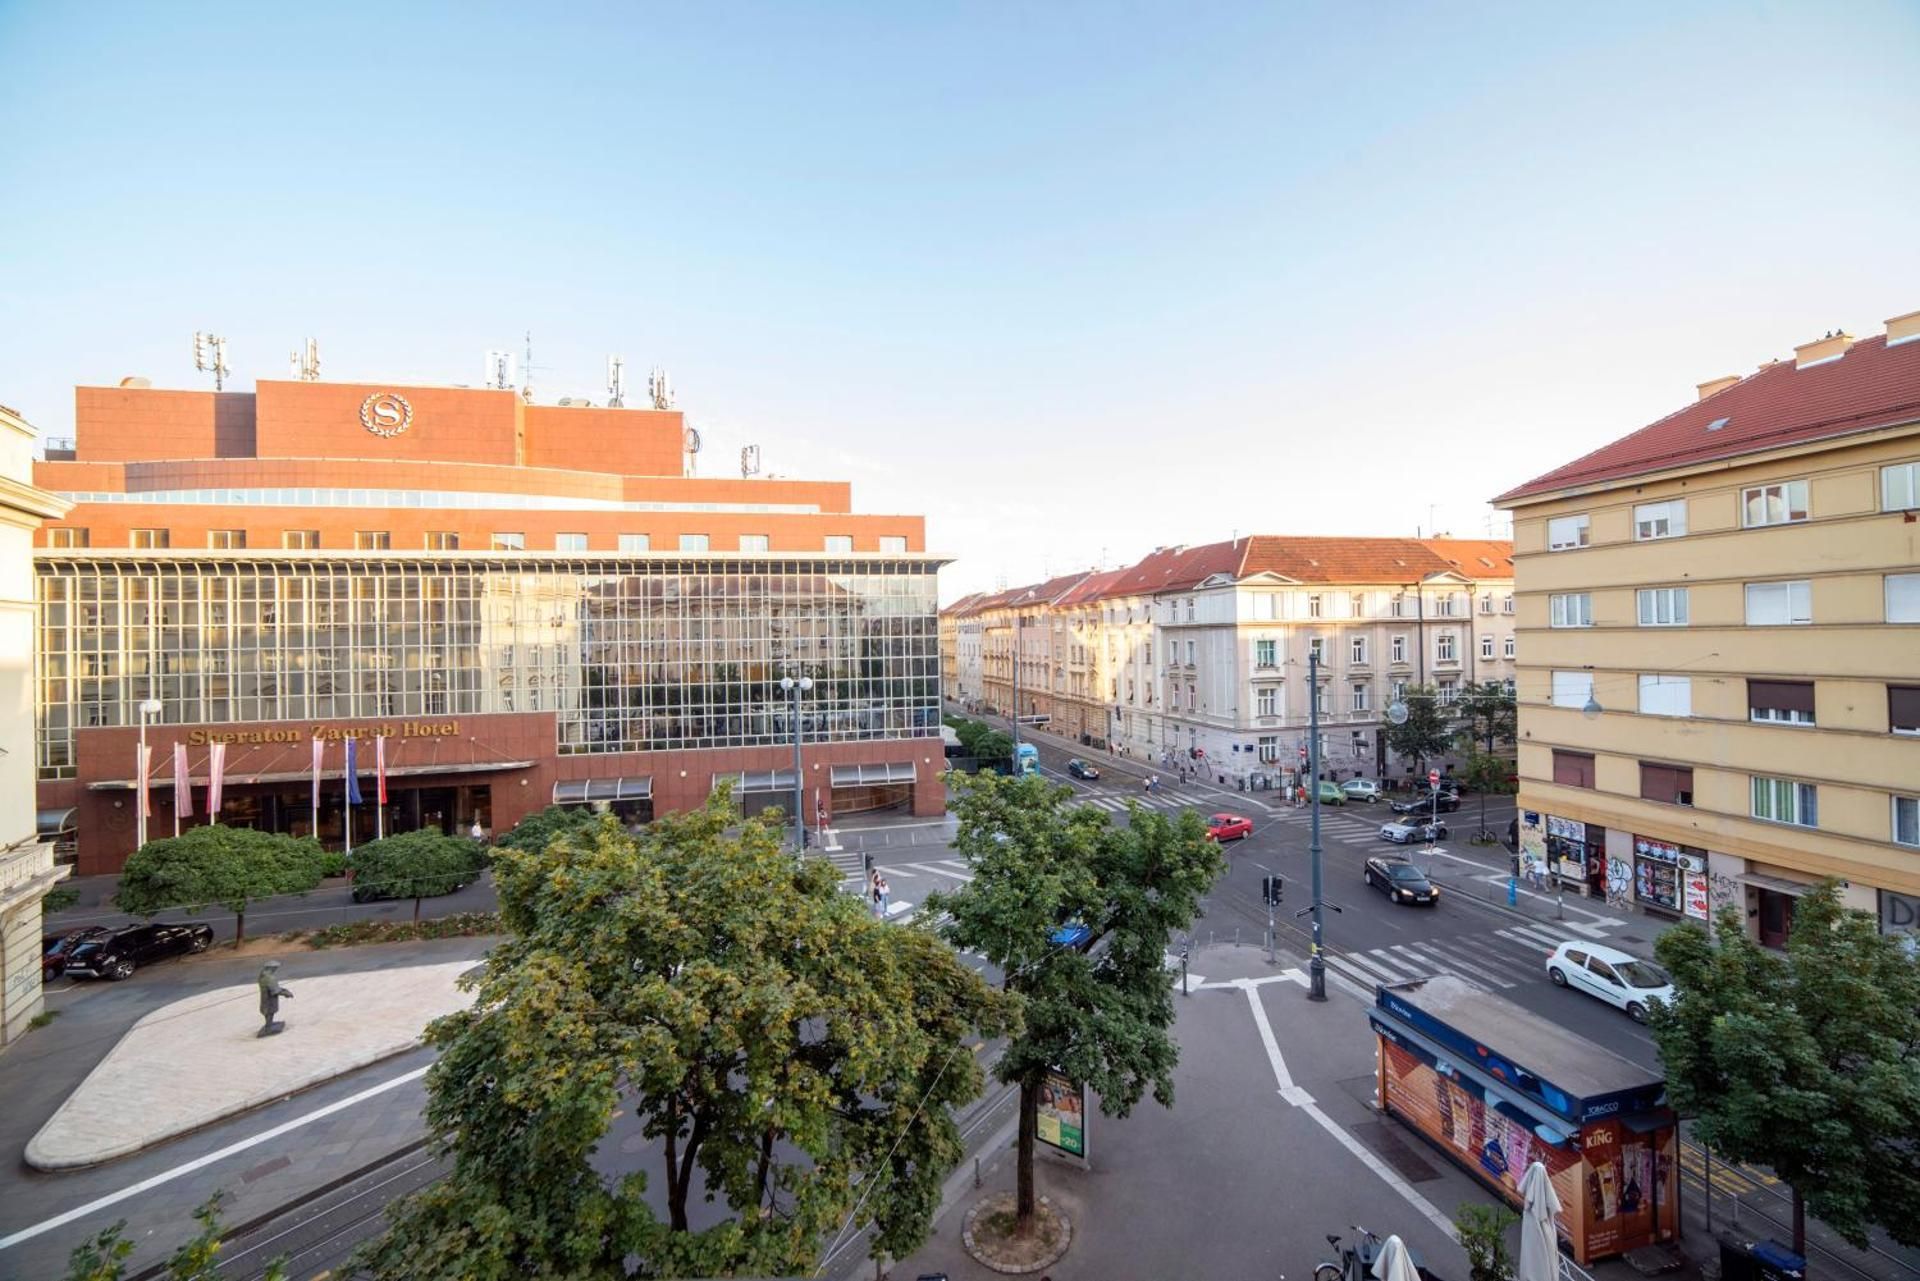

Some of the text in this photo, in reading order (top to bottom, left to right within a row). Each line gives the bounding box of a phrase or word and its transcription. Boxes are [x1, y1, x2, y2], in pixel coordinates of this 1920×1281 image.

[373, 401, 400, 426] S
[188, 720, 460, 746] Sheraton Zagreb Hotel
[1586, 1131, 1613, 1149] KING
